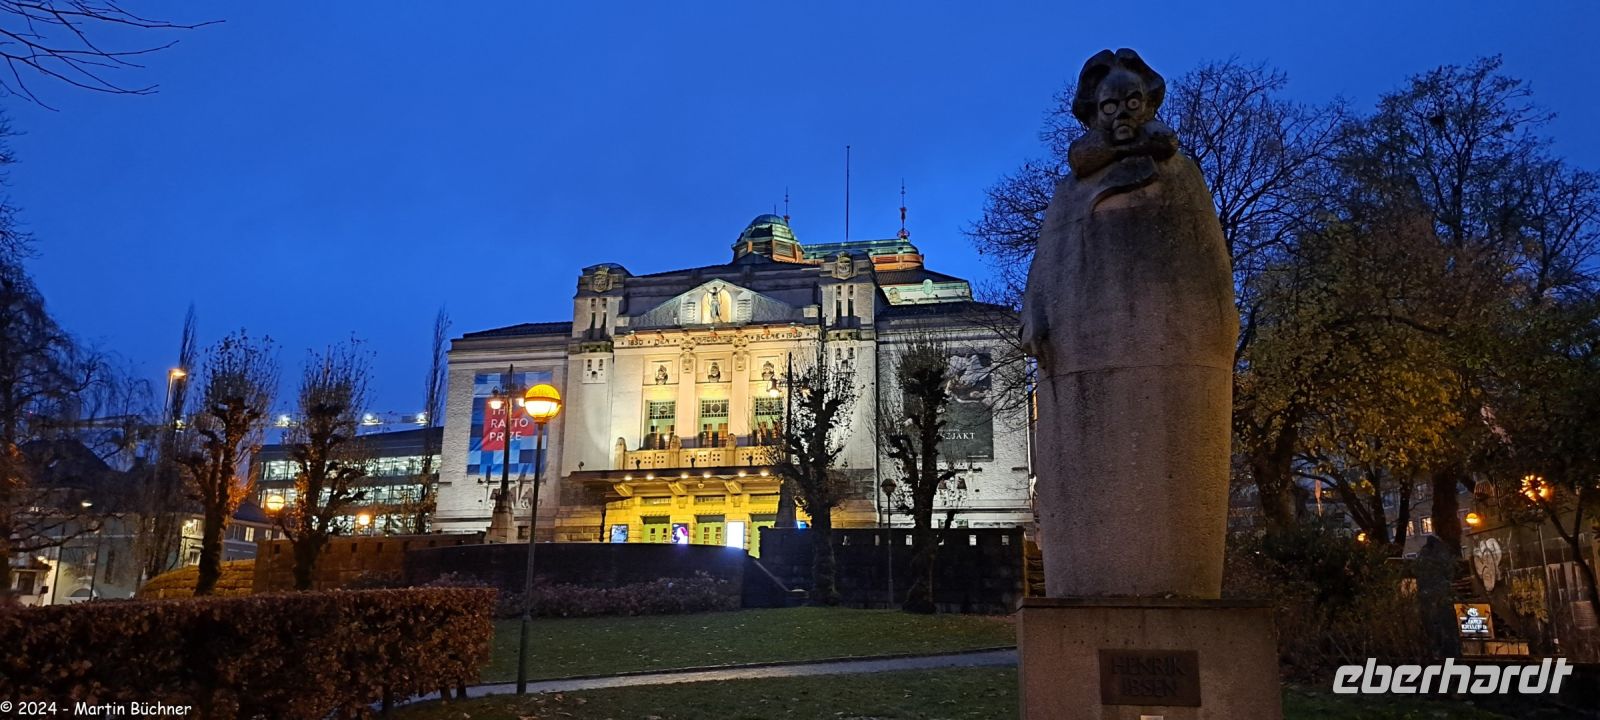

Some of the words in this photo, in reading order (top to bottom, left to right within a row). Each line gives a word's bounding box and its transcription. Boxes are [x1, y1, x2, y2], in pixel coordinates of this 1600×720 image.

[490, 417, 529, 429] RATO
[489, 431, 522, 442] PRZE
[1111, 656, 1186, 675] HENRIK
[1121, 678, 1177, 698] IBSEN
